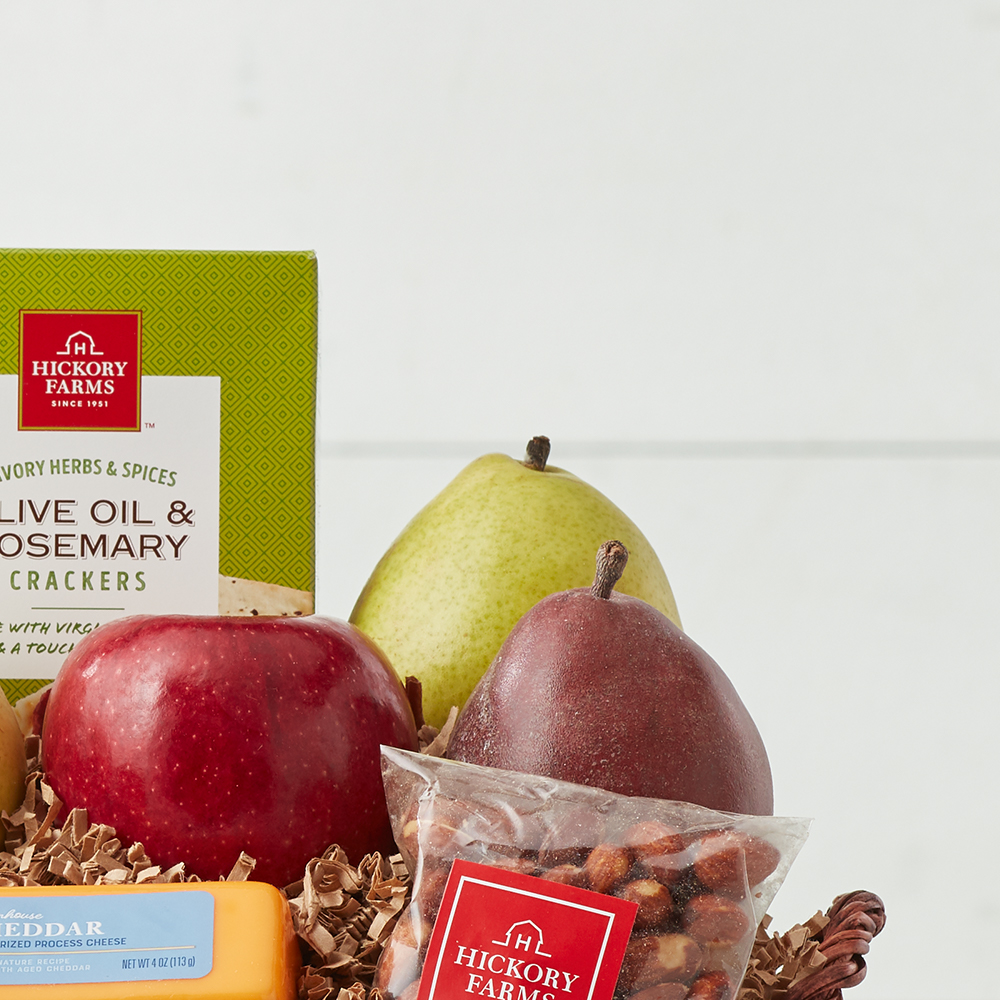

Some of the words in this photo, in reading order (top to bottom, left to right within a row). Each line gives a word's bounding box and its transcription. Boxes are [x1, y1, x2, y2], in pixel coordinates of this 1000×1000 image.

[31, 360, 128, 377] HICKORY
[45, 379, 115, 395] FARMS
[51, 400, 83, 408] SINCE
[87, 400, 109, 408] 1951
[50, 458, 102, 475] HERBS
[106, 460, 118, 476] &
[121, 461, 178, 487] SPICES
[90, 499, 155, 526] OIL
[166, 500, 196, 527] &
[10, 570, 147, 591] CRACKERS
[9, 622, 51, 635] WITH
[10, 642, 21, 655] A
[34, 939, 83, 948] PROCESS
[86, 937, 127, 947] CHEESE
[17, 965, 43, 973] AGED
[122, 959, 136, 969] NET
[138, 958, 150, 968] WT
[151, 958, 157, 968] 4
[158, 957, 169, 968] OZ
[169, 956, 186, 968] (113
[454, 945, 580, 993] HICKORY
